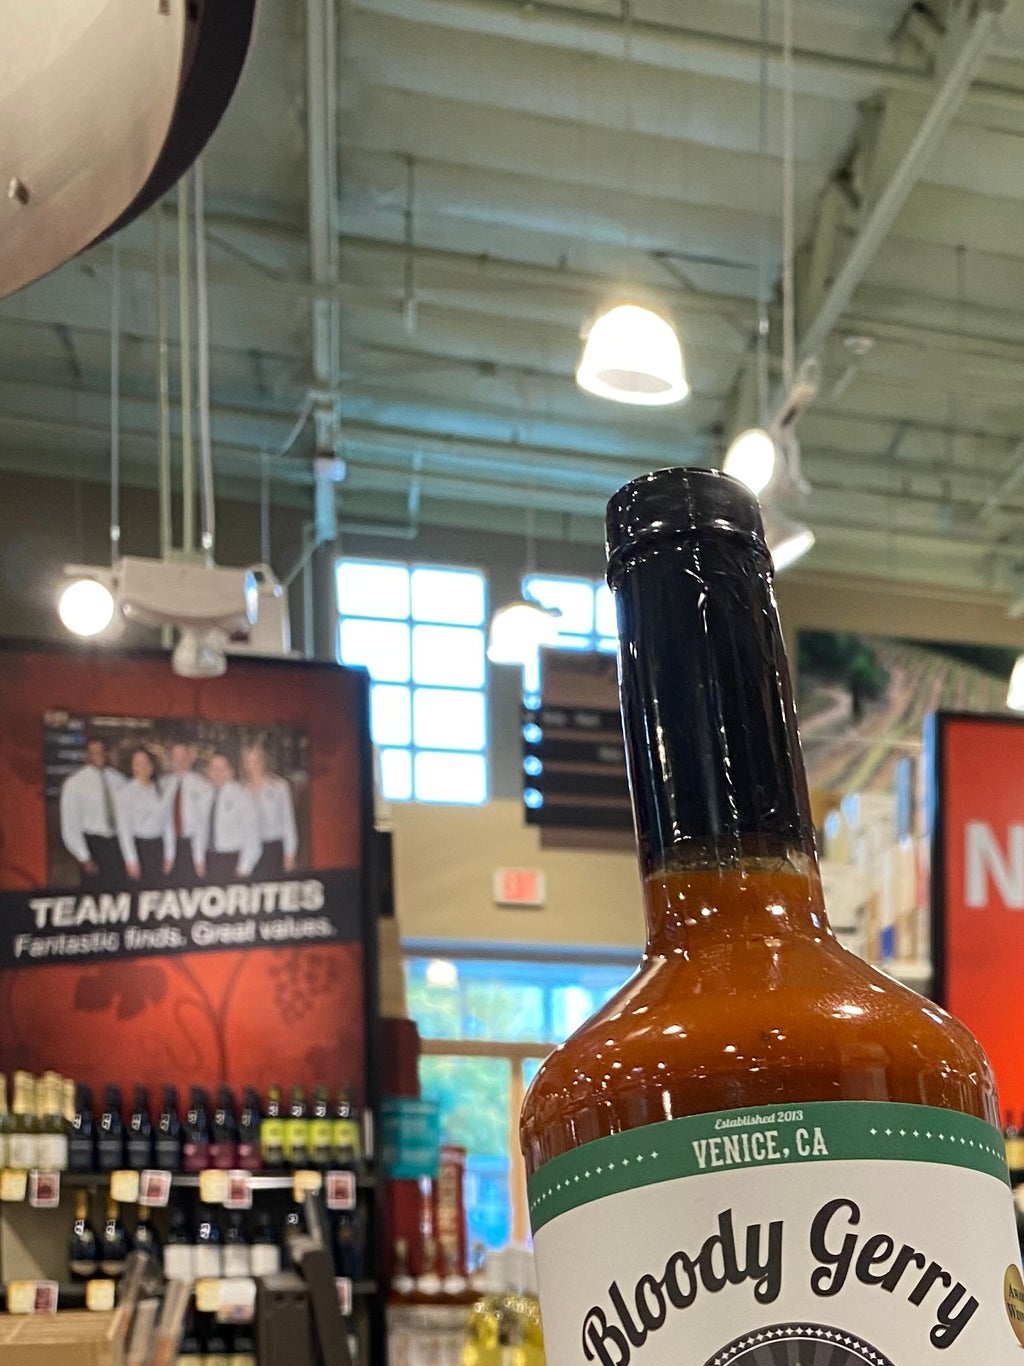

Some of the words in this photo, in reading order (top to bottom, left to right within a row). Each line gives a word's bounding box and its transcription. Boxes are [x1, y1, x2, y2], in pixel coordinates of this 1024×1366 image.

[29, 892, 132, 928] TEAM
[137, 879, 326, 921] FAVORITES
[14, 930, 120, 958] Fantastic
[191, 919, 256, 946] Great
[714, 1112, 776, 1130] Established
[777, 1110, 804, 1122] 2013
[692, 1130, 790, 1169] VENICE,
[795, 1127, 829, 1157] CA
[809, 1198, 980, 1350] Gerry
